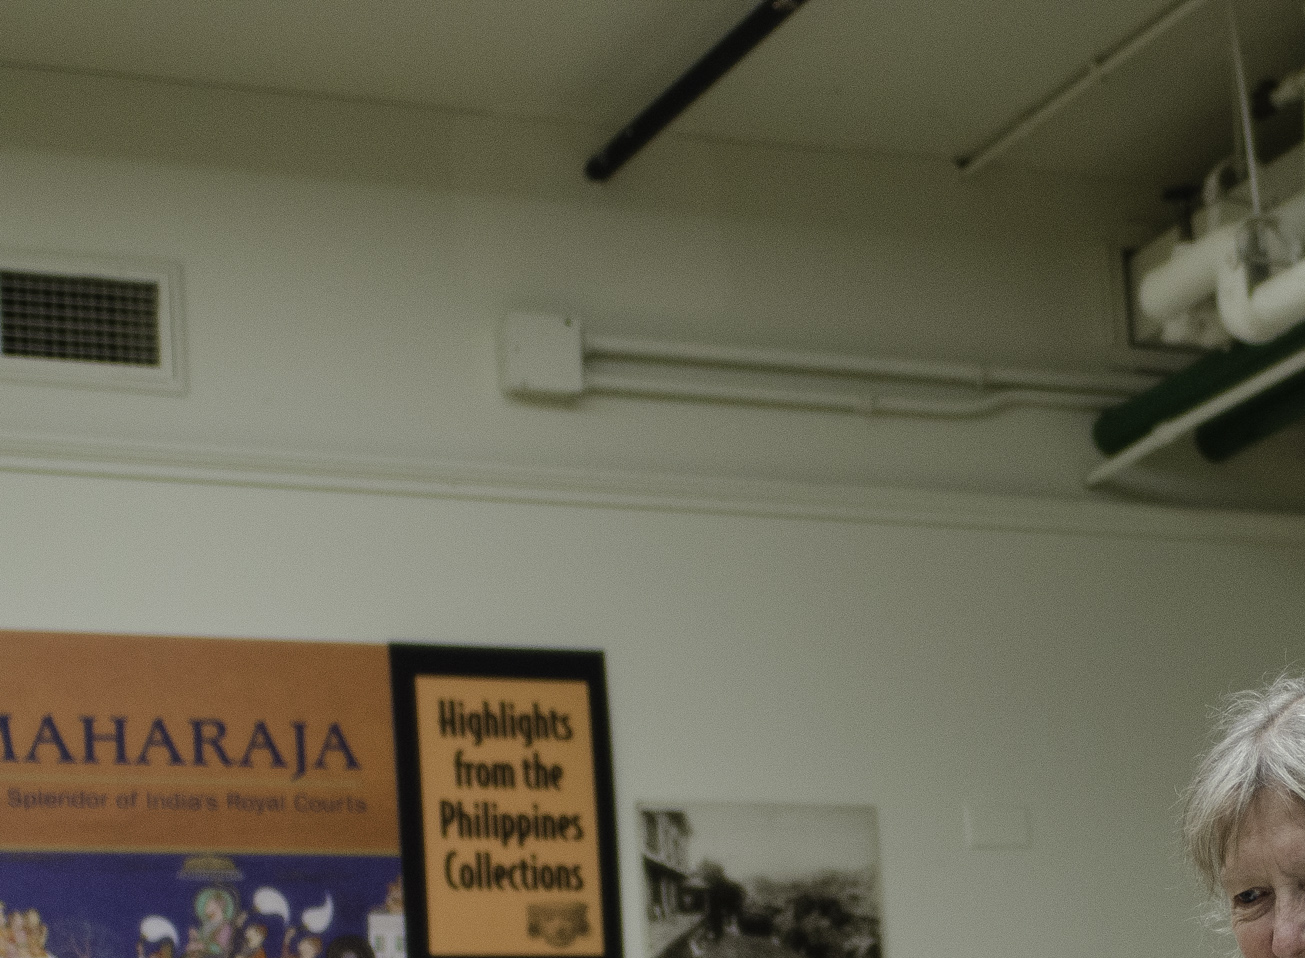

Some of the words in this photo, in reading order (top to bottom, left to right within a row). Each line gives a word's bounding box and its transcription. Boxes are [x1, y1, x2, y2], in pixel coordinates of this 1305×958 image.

[437, 697, 574, 748] Highlights
[454, 749, 516, 789] from
[521, 751, 564, 791] the
[7, 788, 108, 811] Splendor
[116, 790, 138, 810] of
[146, 791, 219, 812] India's
[227, 792, 286, 815] Royal
[294, 793, 368, 814] Courts
[439, 798, 585, 848] Philippines
[444, 850, 585, 892] Collections
